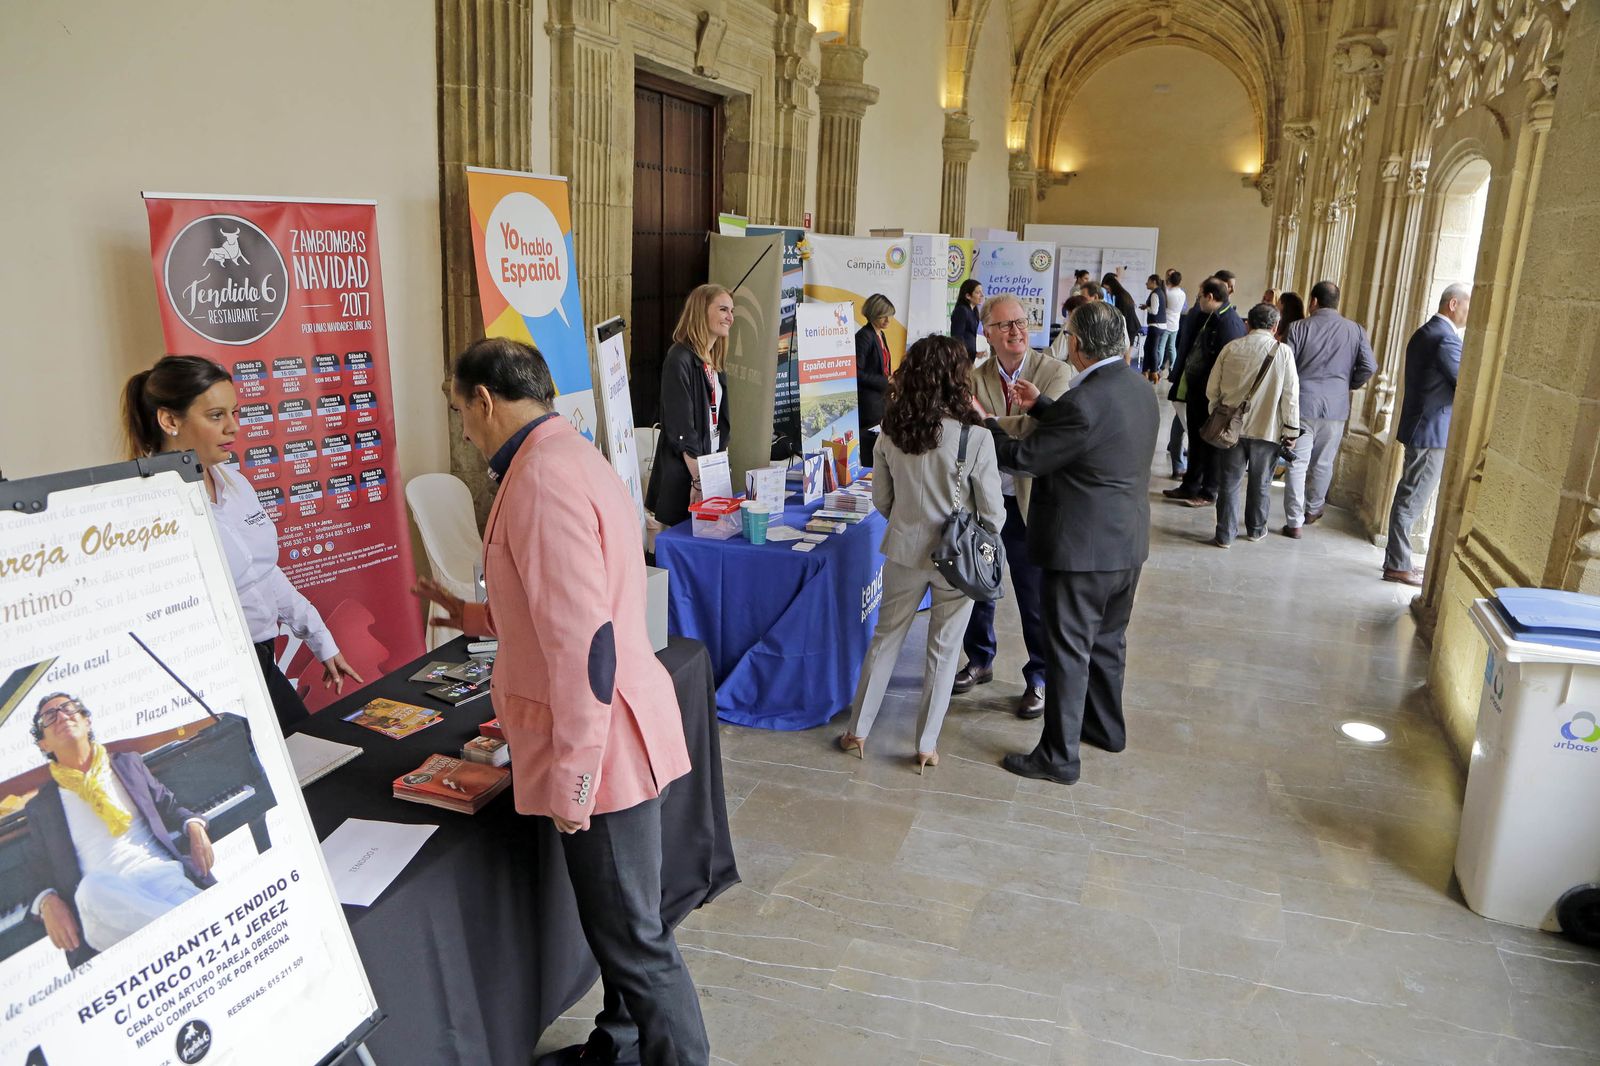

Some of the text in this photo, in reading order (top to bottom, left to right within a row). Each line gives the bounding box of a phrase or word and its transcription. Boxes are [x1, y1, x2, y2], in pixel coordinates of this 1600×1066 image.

[290, 230, 366, 253] ZAMBOMBAS
[500, 222, 519, 250] Yo
[521, 237, 552, 256] hablo
[293, 255, 370, 290] NAVIDAD
[501, 256, 561, 288] Español
[846, 260, 886, 271] Campiña
[1012, 276, 1032, 284] play
[182, 273, 276, 316] Tendido 6
[340, 292, 370, 317] 2017
[208, 308, 259, 324] RESTAURANTE
[302, 323, 313, 334] POR
[805, 325, 848, 337] tenidiomas
[803, 360, 826, 372] Español
[80, 517, 180, 556] Obregón
[146, 595, 200, 622] ser amado
[47, 650, 110, 682] cielo azul
[136, 689, 204, 726] Plaza Nueva
[77, 921, 222, 1024] RESTATURANTE
[225, 878, 287, 926] TENDIDO
[290, 870, 299, 882] 6
[114, 899, 289, 1025] C/ CIRCO 12-14 JEREZ
[5, 1003, 23, 1021] de
[28, 960, 93, 1007] azahares
[126, 1014, 154, 1038] CENA
[155, 997, 176, 1017] CON
[178, 970, 215, 1001] ARTURO
[216, 947, 250, 973] PAREJA
[166, 986, 215, 1026] COMPLETO
[216, 974, 233, 990] 30€
[233, 961, 253, 978] POR
[253, 934, 290, 964] PERSONA
[227, 986, 267, 1018] RESERVAS:
[267, 975, 280, 989] 615
[280, 966, 293, 979] 211
